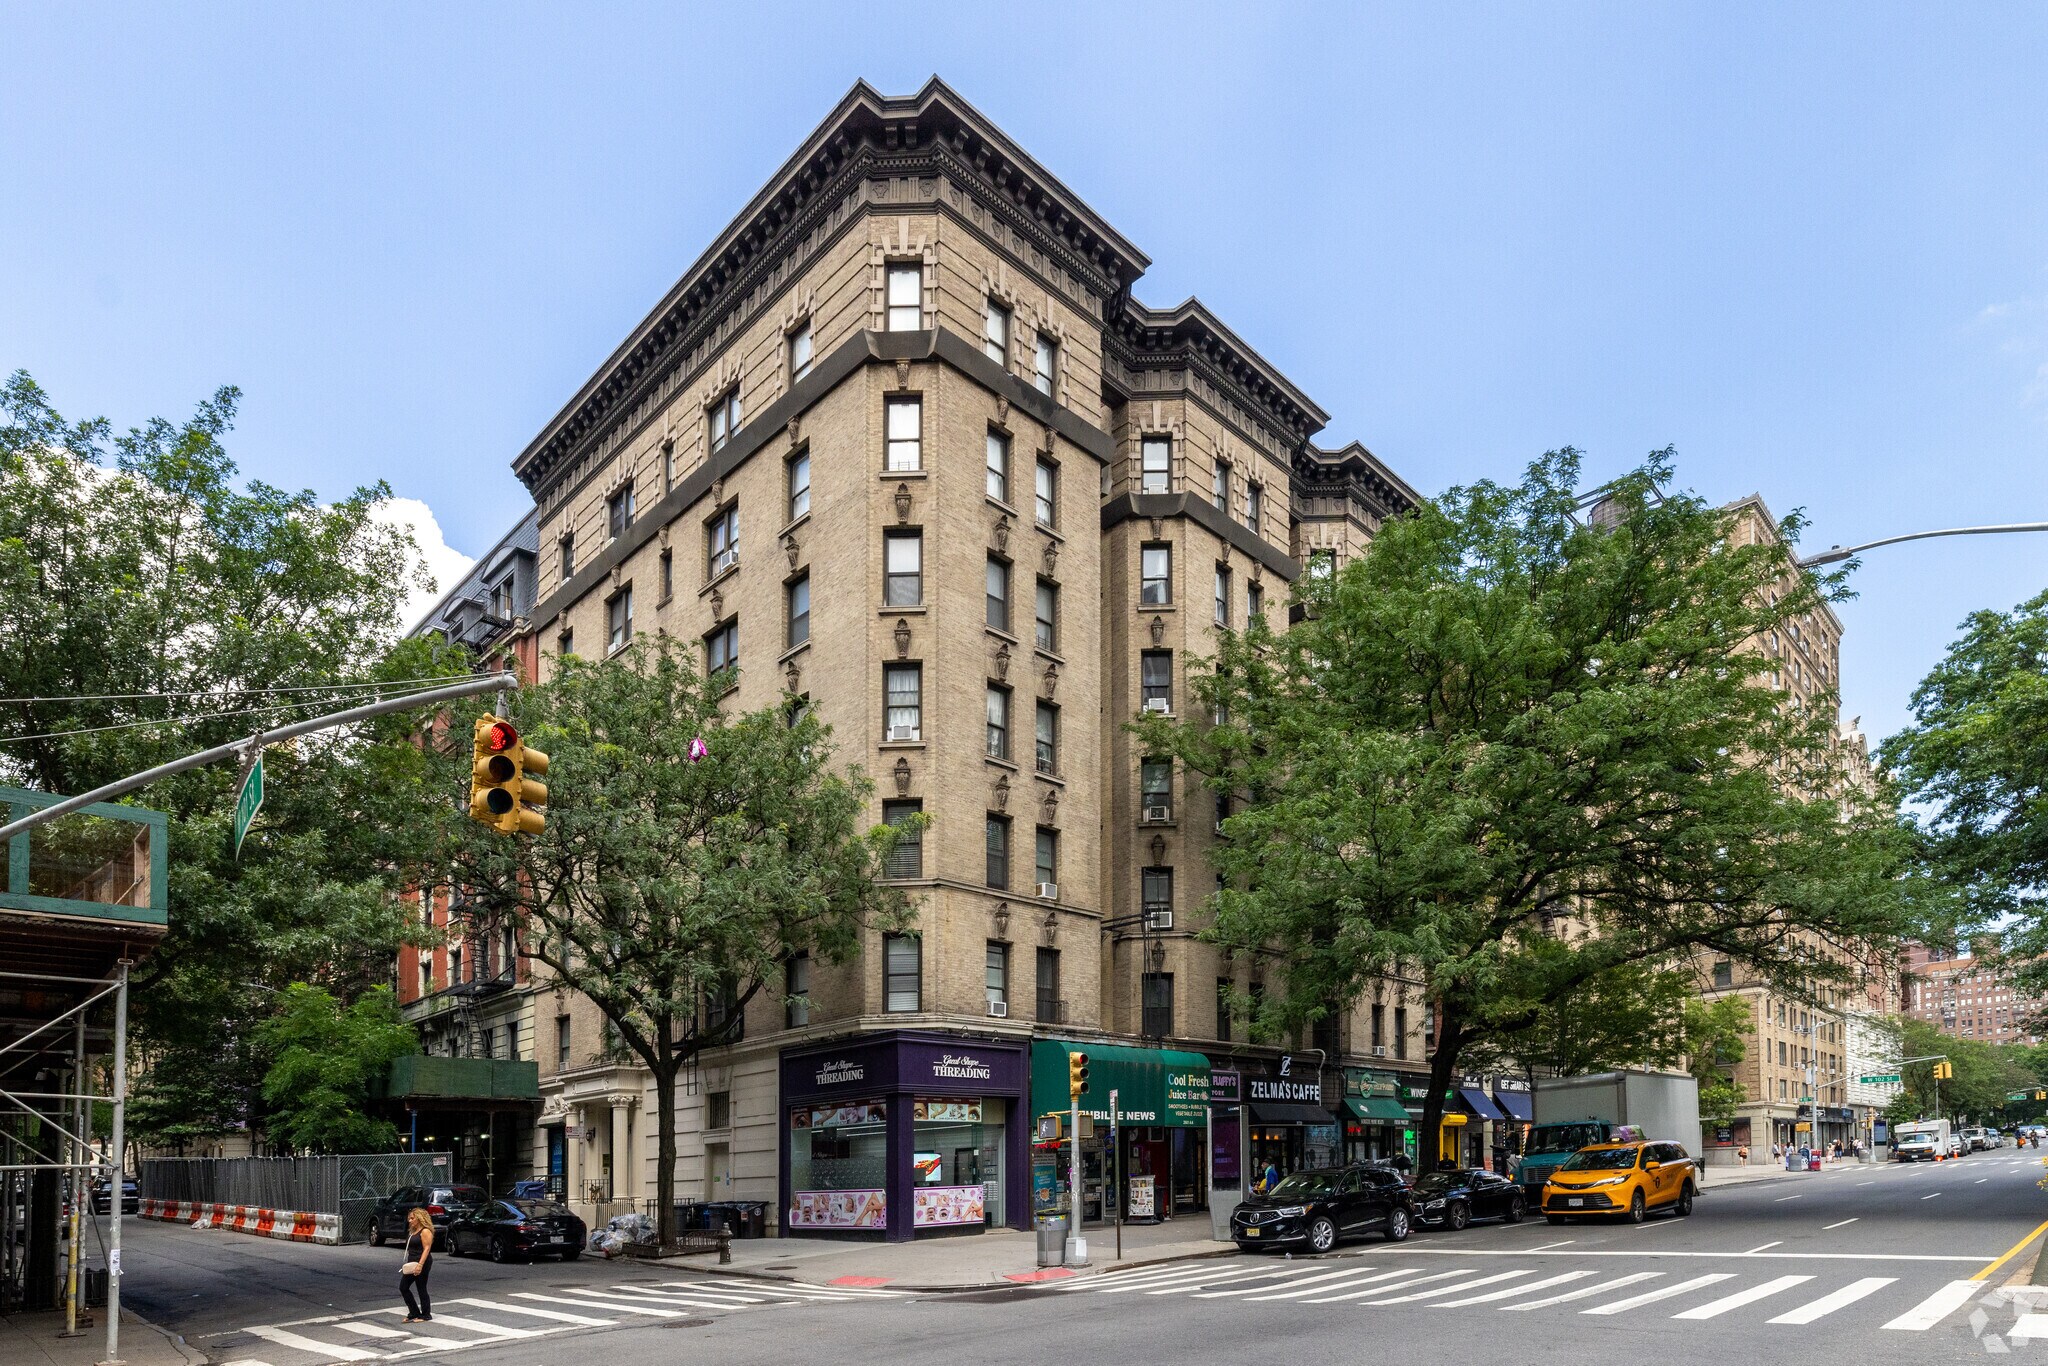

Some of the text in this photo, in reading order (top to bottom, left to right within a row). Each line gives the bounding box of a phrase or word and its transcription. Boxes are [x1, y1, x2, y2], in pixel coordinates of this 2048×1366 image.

[960, 1056, 979, 1068] Shape
[815, 1068, 864, 1085] THREADING
[932, 1065, 990, 1080] THREADING
[1168, 1073, 1209, 1087] Cool Fresh
[1501, 1079, 1510, 1090] GET
[1168, 1088, 1200, 1100] Juice Bar
[1251, 1080, 1320, 1101] ZELMA'S CAFFE
[1126, 1111, 1156, 1121] NEWS
